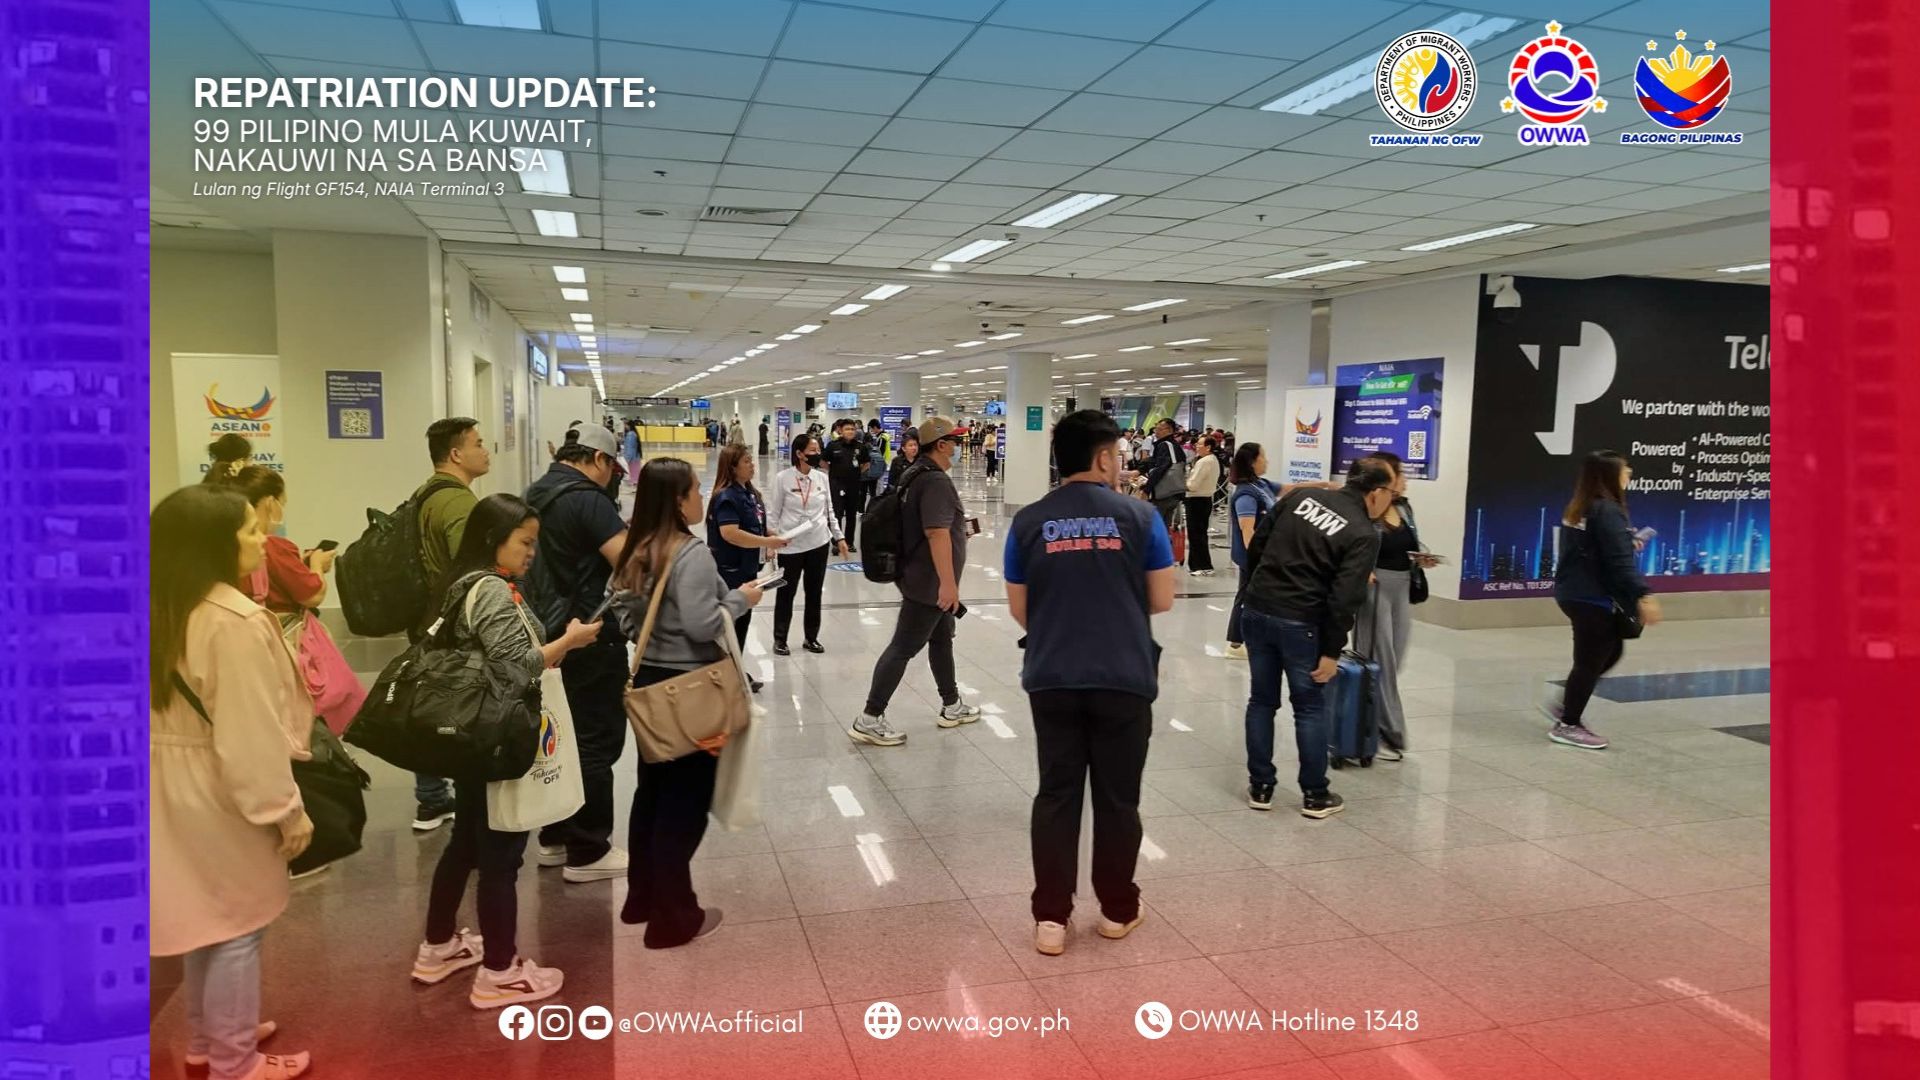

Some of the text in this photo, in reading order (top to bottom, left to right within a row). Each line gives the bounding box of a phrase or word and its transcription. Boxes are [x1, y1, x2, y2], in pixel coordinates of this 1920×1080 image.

[1724, 334, 1770, 370] Tel
[1622, 399, 1643, 414] We
[1644, 401, 1695, 418] partner
[1697, 400, 1725, 416] with
[1728, 401, 1750, 417] the
[211, 422, 261, 432] ASEAN
[1698, 432, 1762, 446] AI-Powered
[1631, 441, 1687, 456] Powered
[1697, 451, 1738, 464] Process
[1671, 462, 1685, 476] by
[1624, 477, 1683, 494] w.tp.com
[1694, 487, 1750, 503] Enterprise
[1293, 499, 1346, 536] DMW
[1042, 517, 1121, 541] OWWA
[1482, 582, 1498, 592] ASC
